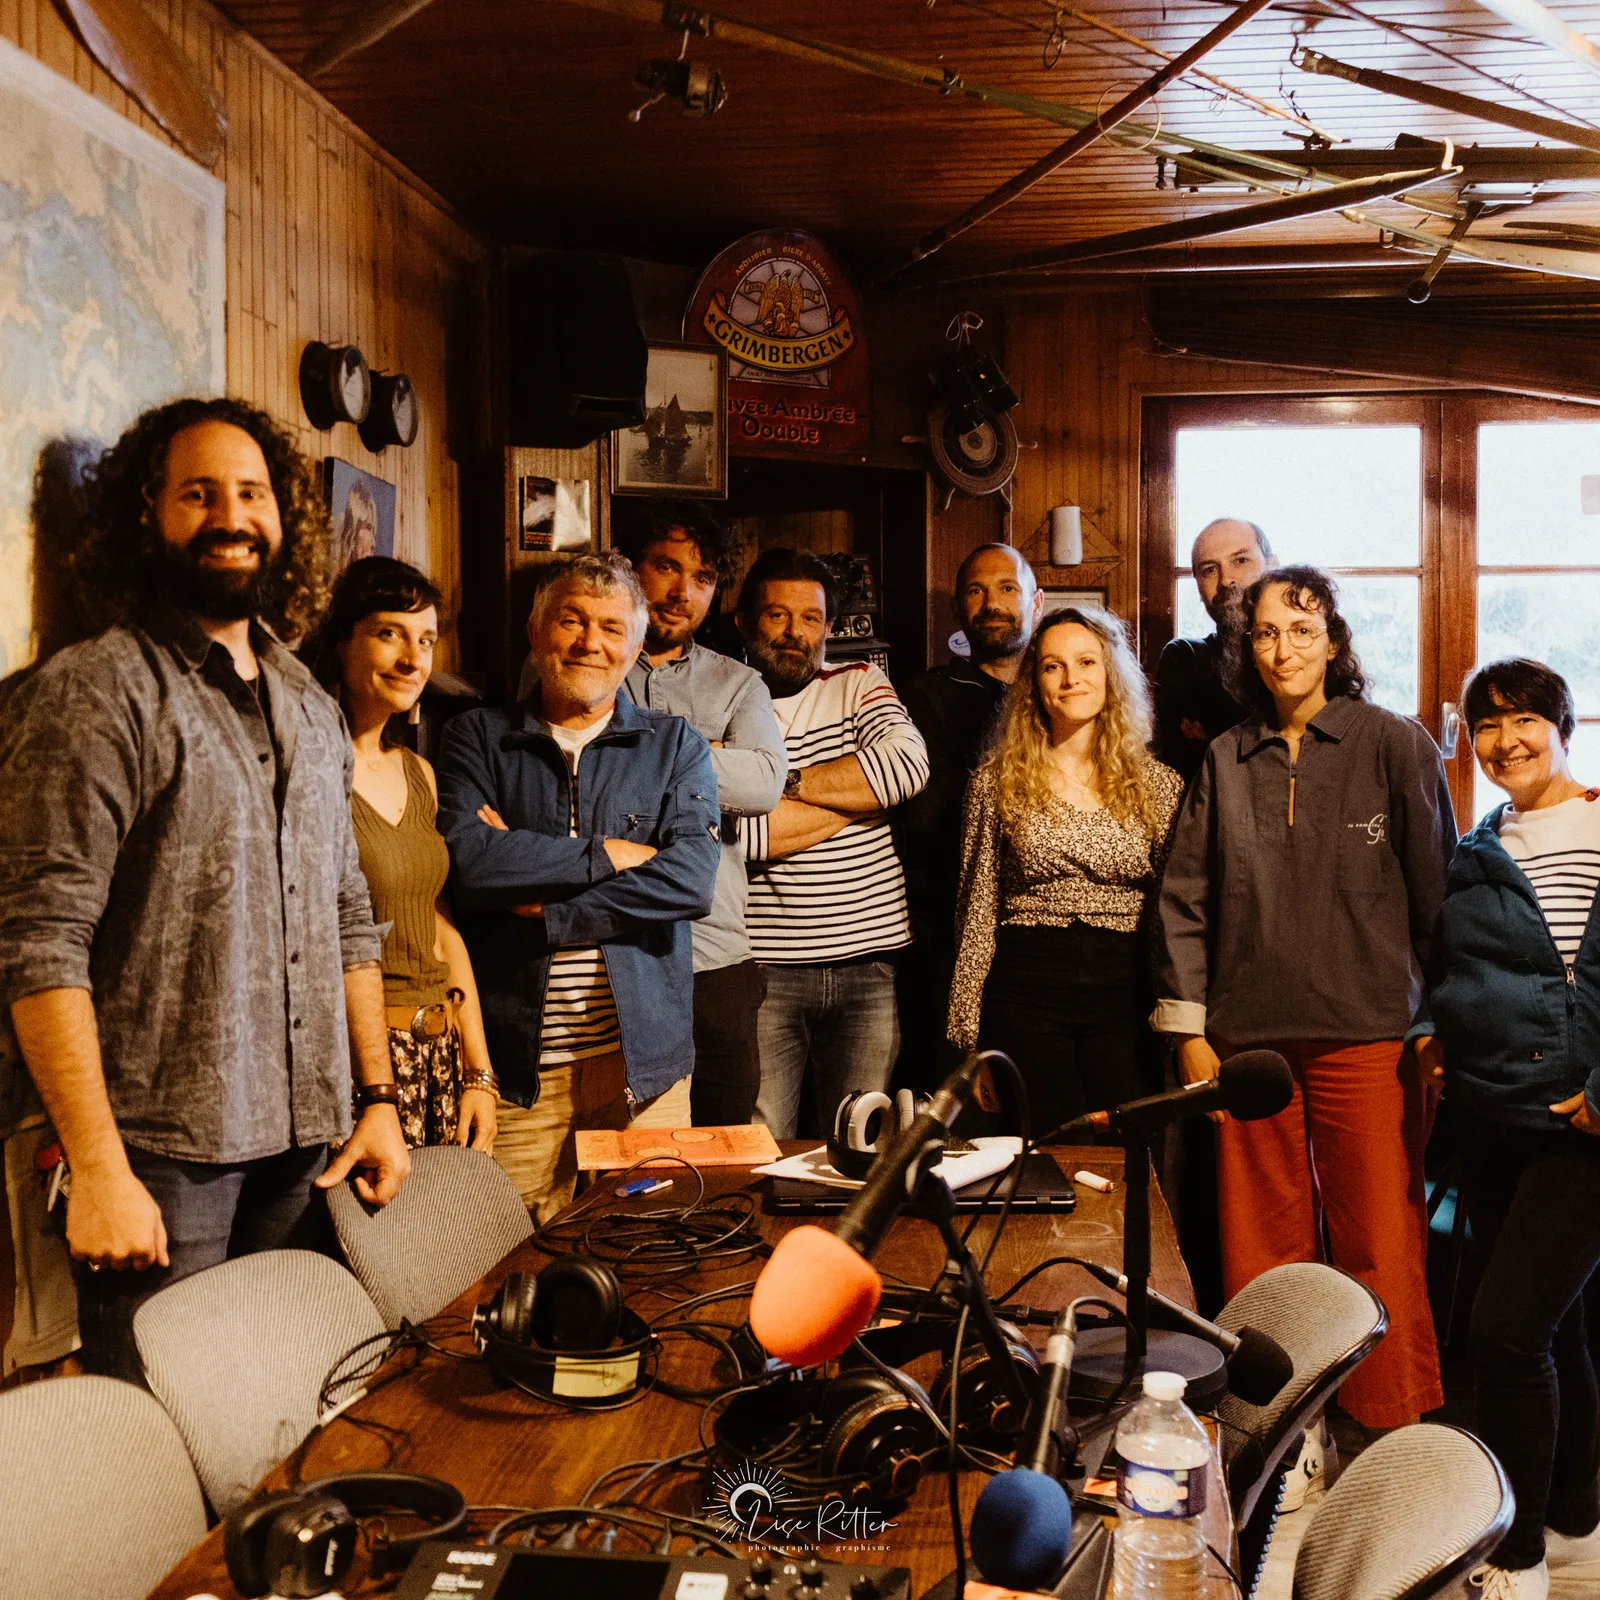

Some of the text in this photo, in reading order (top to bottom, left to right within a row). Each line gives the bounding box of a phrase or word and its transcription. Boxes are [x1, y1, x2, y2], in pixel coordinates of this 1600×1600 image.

[714, 320, 844, 365] GRIMBERGEN
[772, 397, 856, 424] Ambrée
[740, 413, 820, 444] Double
